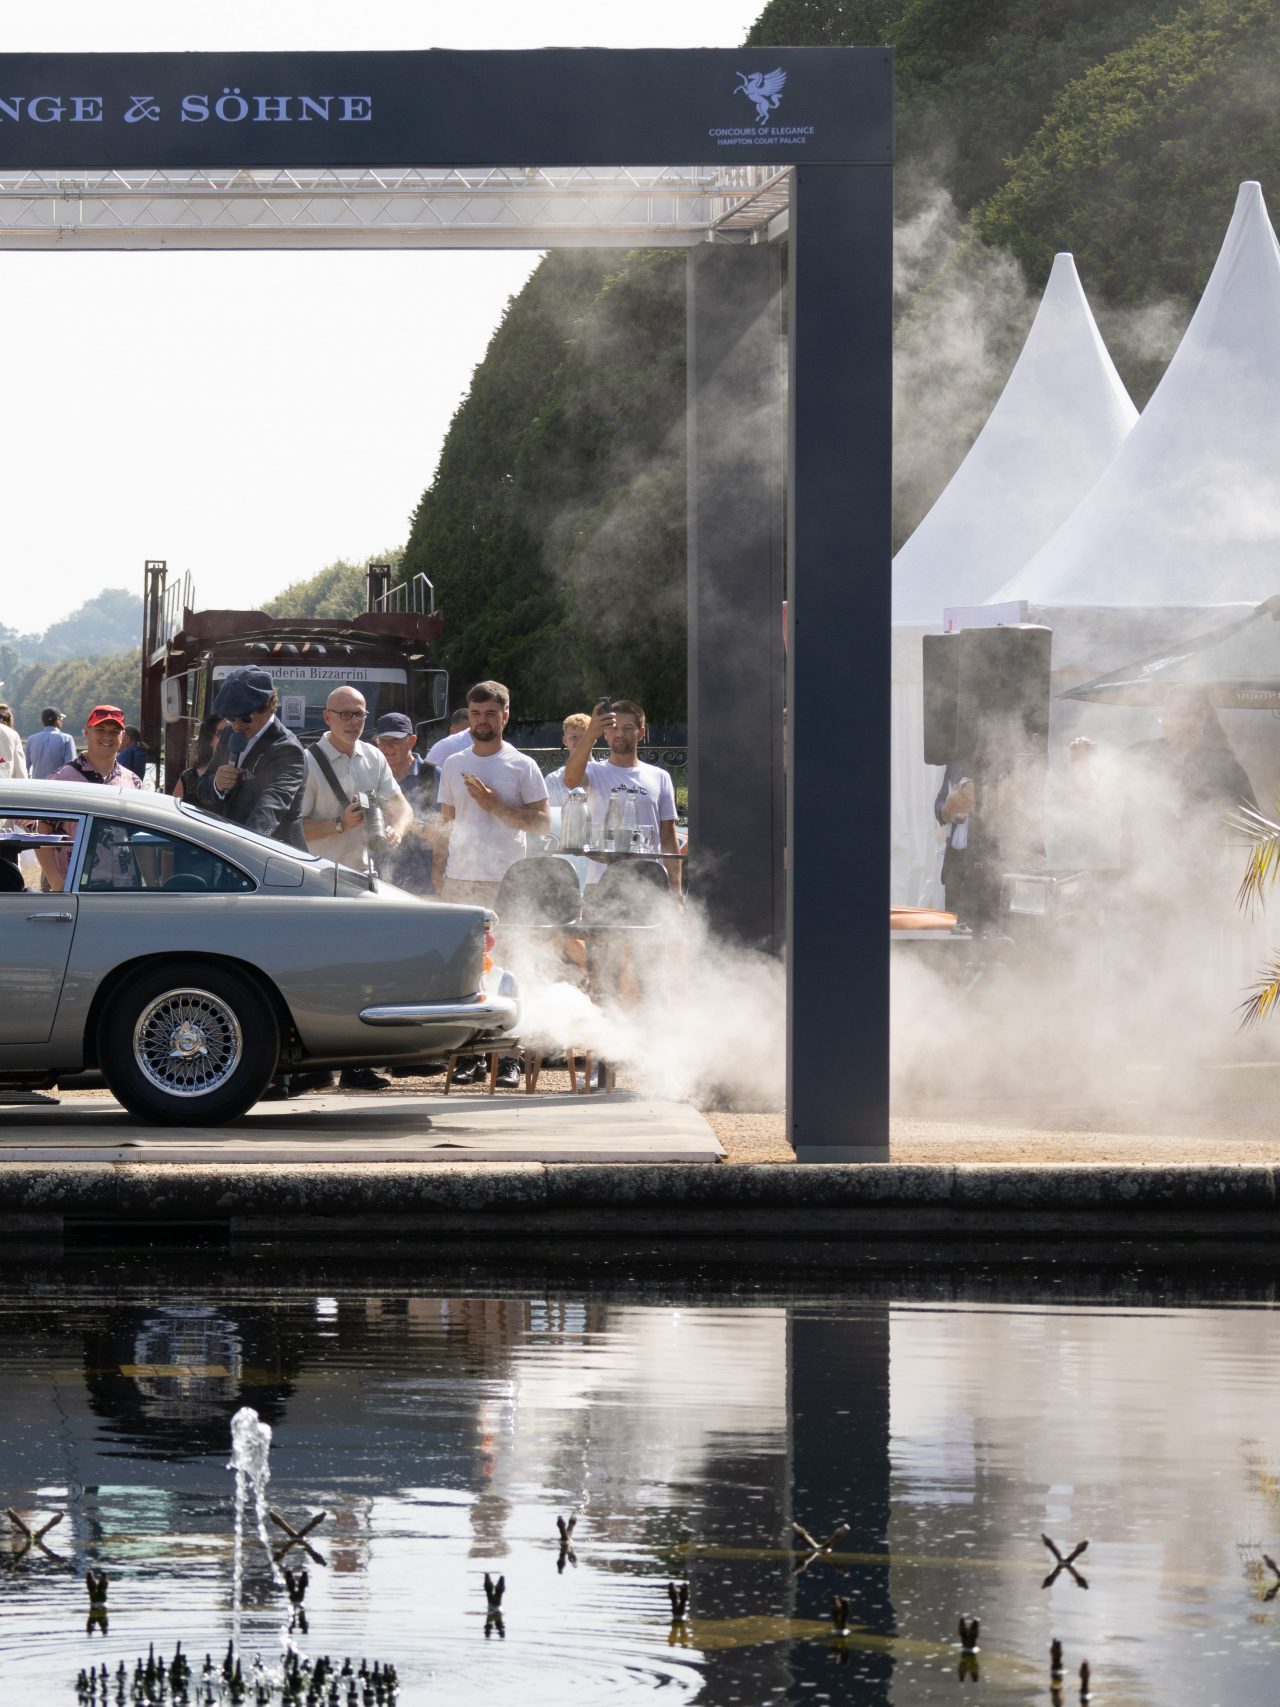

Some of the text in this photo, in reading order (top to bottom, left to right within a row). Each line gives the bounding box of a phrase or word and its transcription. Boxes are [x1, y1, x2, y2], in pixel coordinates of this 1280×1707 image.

[123, 95, 161, 123] &
[181, 87, 373, 122] SÖHNE
[708, 126, 815, 136] CONCOURS OF ELEGANCE
[717, 137, 753, 145] HAMPTON
[779, 136, 807, 144] PALACE
[269, 667, 368, 680] uderia Bizzarrini
